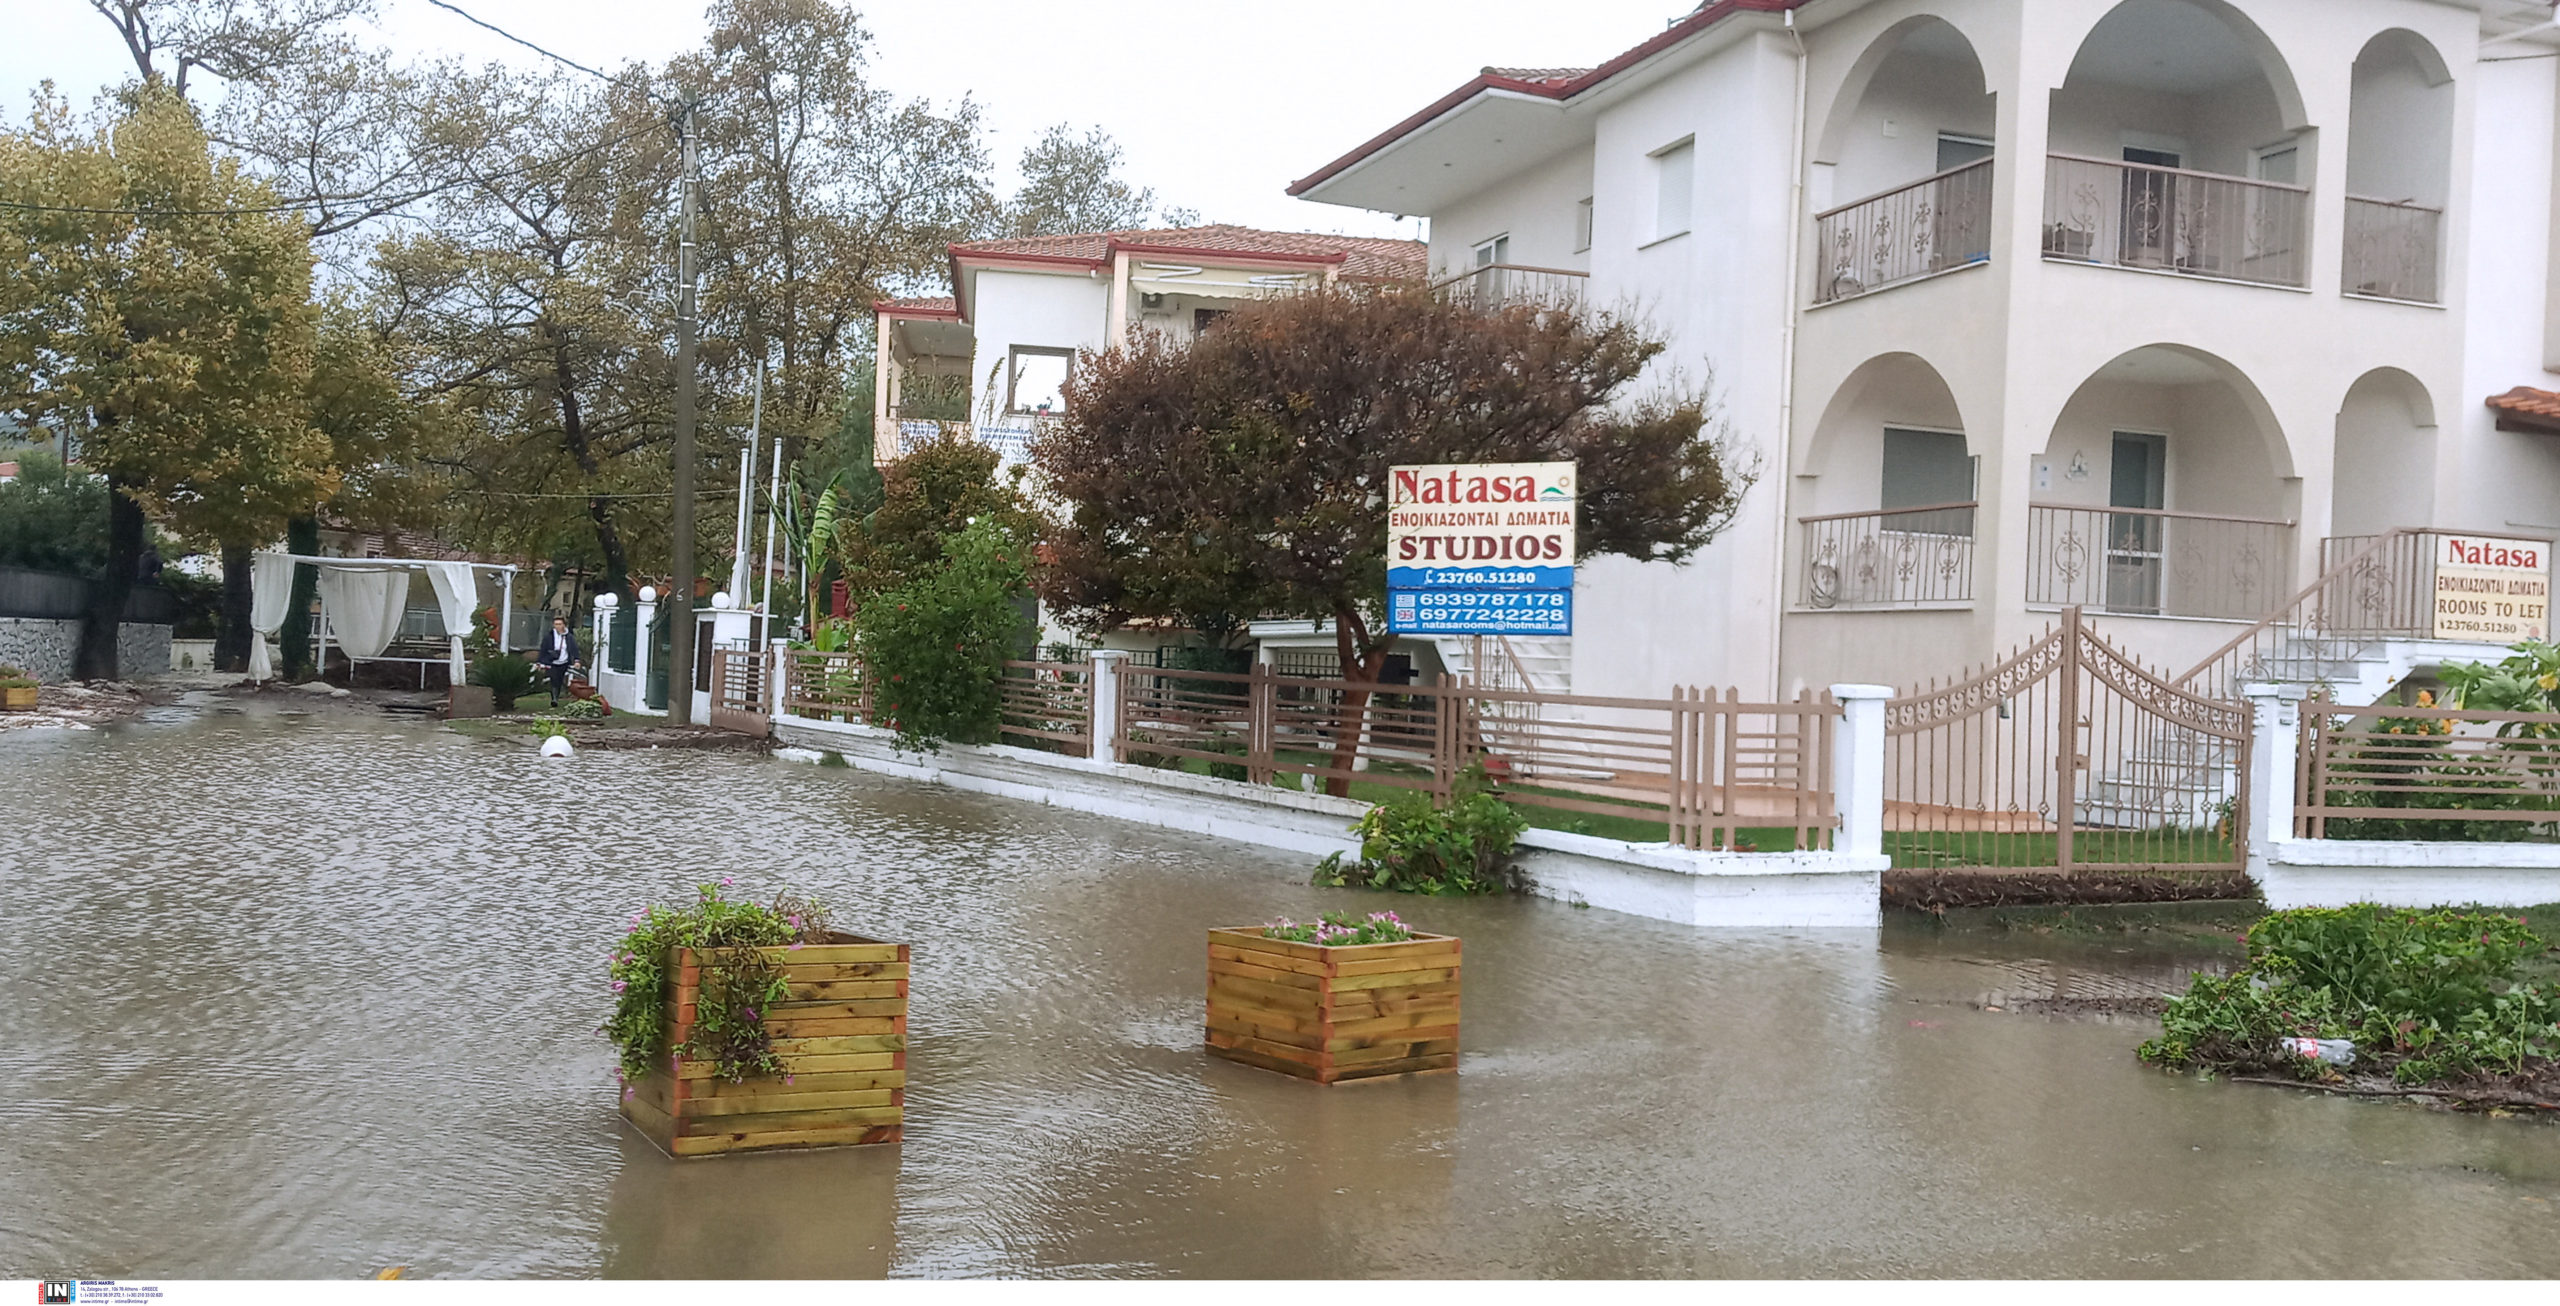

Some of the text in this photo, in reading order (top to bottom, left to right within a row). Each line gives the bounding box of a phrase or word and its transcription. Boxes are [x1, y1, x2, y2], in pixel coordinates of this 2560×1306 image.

[1394, 470, 1538, 504] Natasa
[1391, 511, 1571, 527] ΕΝΟΙΚΙΑΖΟΝΤΑΙ ΔΩΜΑΤΙΑ
[1399, 535, 1562, 560] STUDIOS
[2449, 540, 2538, 568] Natasa
[1436, 572, 1536, 584] 23760.51280
[2438, 576, 2545, 596] ΕΝΟΙΚΙΑΖΟΝΤΑΙ ΔΩΜΑΤΙΑ
[1420, 593, 1564, 606] 6939787178
[1420, 608, 1564, 621] 6977242228
[2438, 599, 2544, 618] ROOMS TO LET
[1422, 621, 1568, 631] natasarooms@hotmail.com
[2446, 620, 2517, 633] 23760.51280
